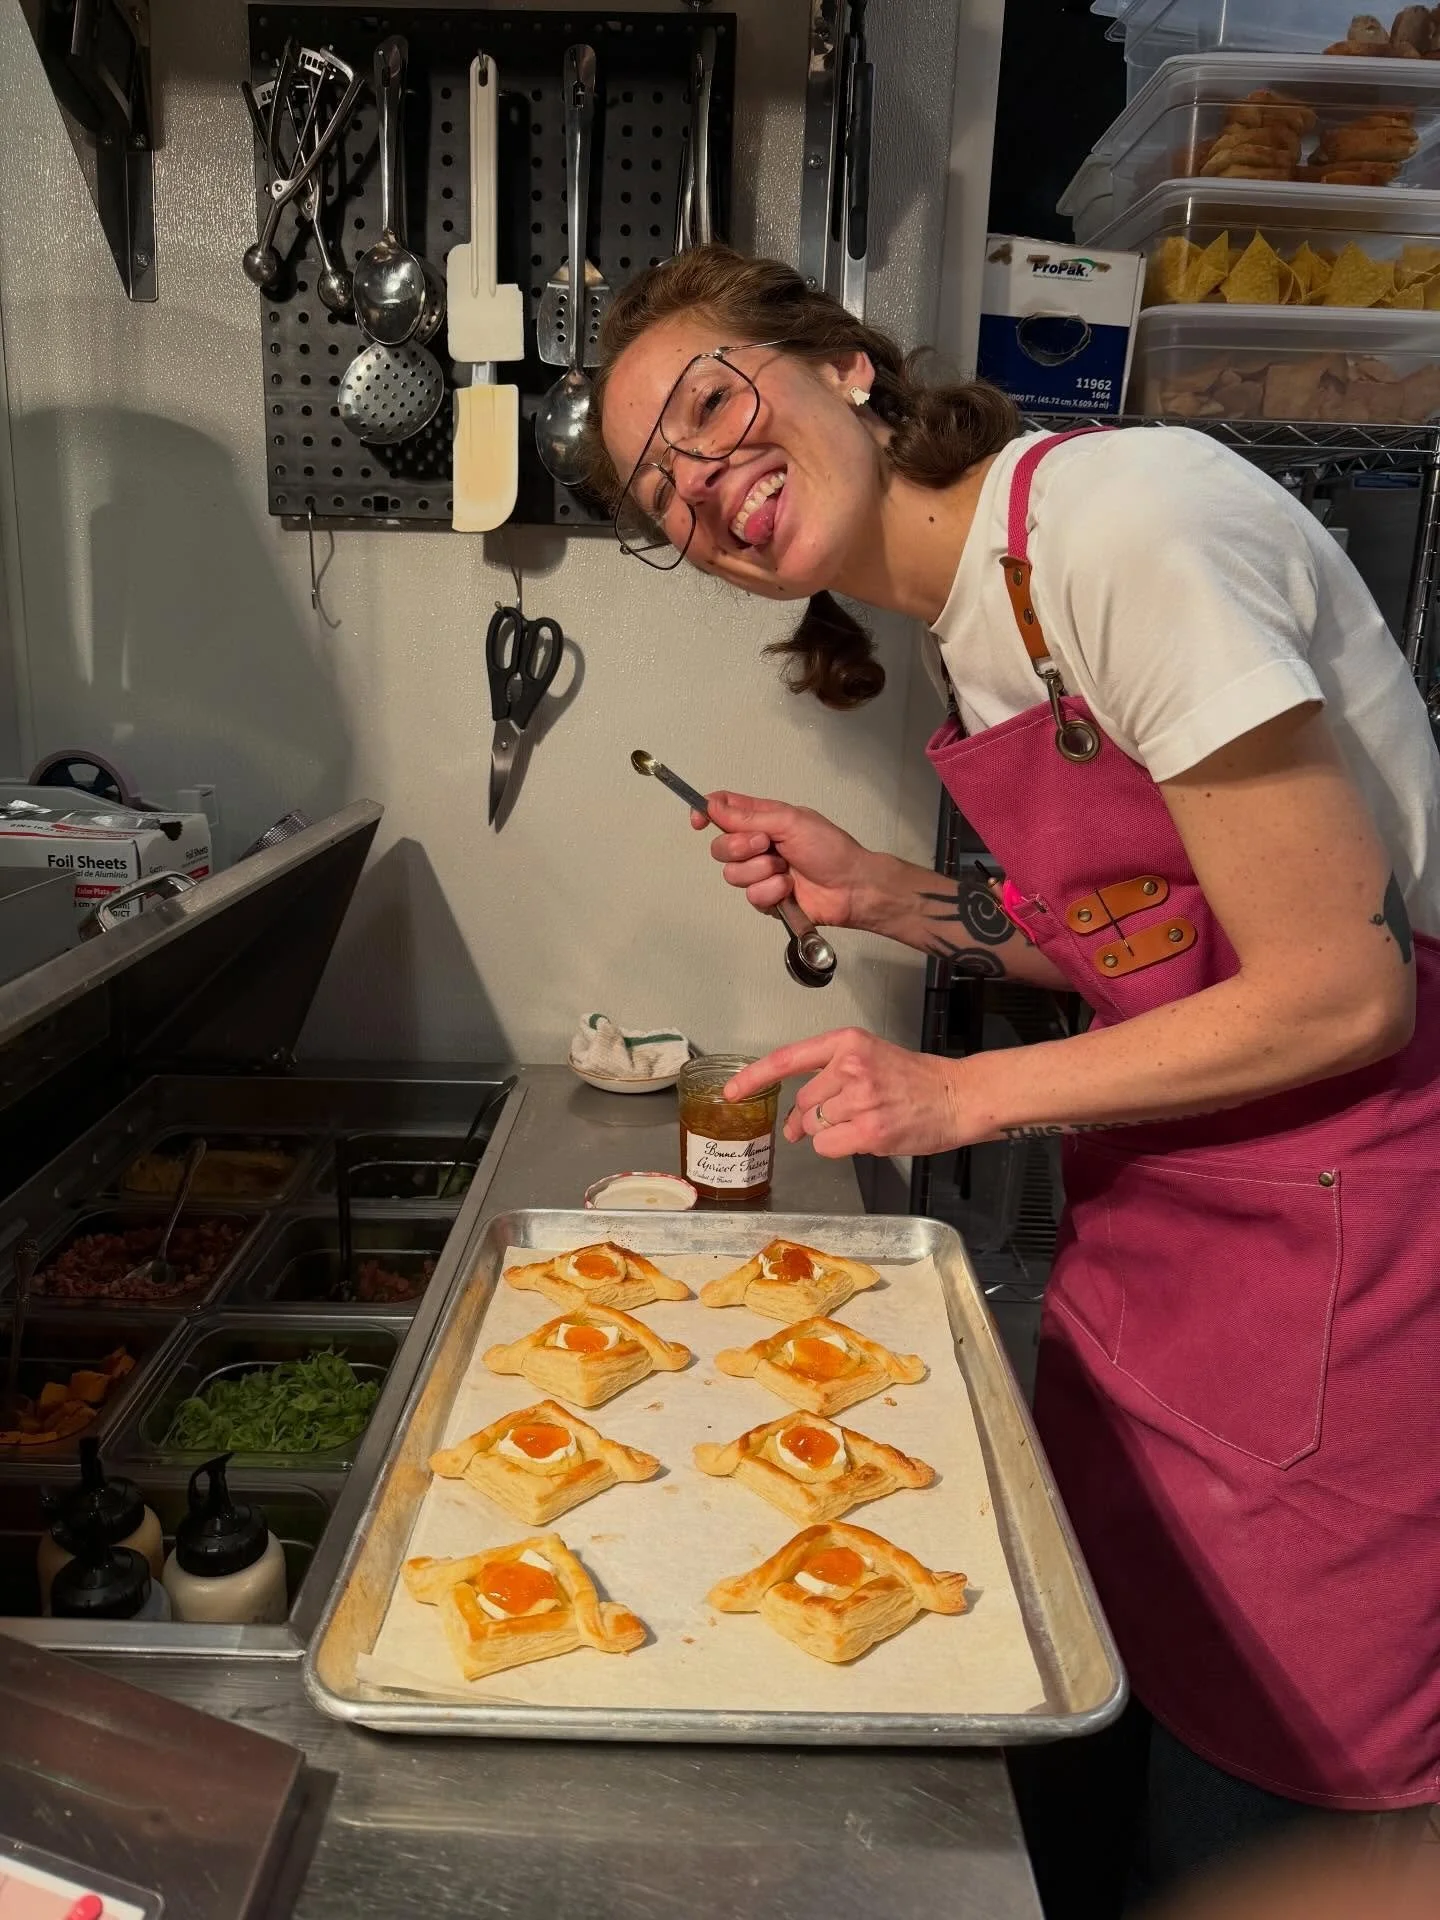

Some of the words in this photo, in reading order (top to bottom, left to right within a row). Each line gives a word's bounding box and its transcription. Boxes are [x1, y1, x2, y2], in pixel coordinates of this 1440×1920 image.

[1076, 377, 1112, 391] 11962
[1091, 391, 1111, 400] 1664
[47, 854, 74, 868] Foil
[77, 855, 128, 870] Sheets
[704, 1141, 737, 1158] Bonne
[697, 1157, 736, 1173] Apricot
